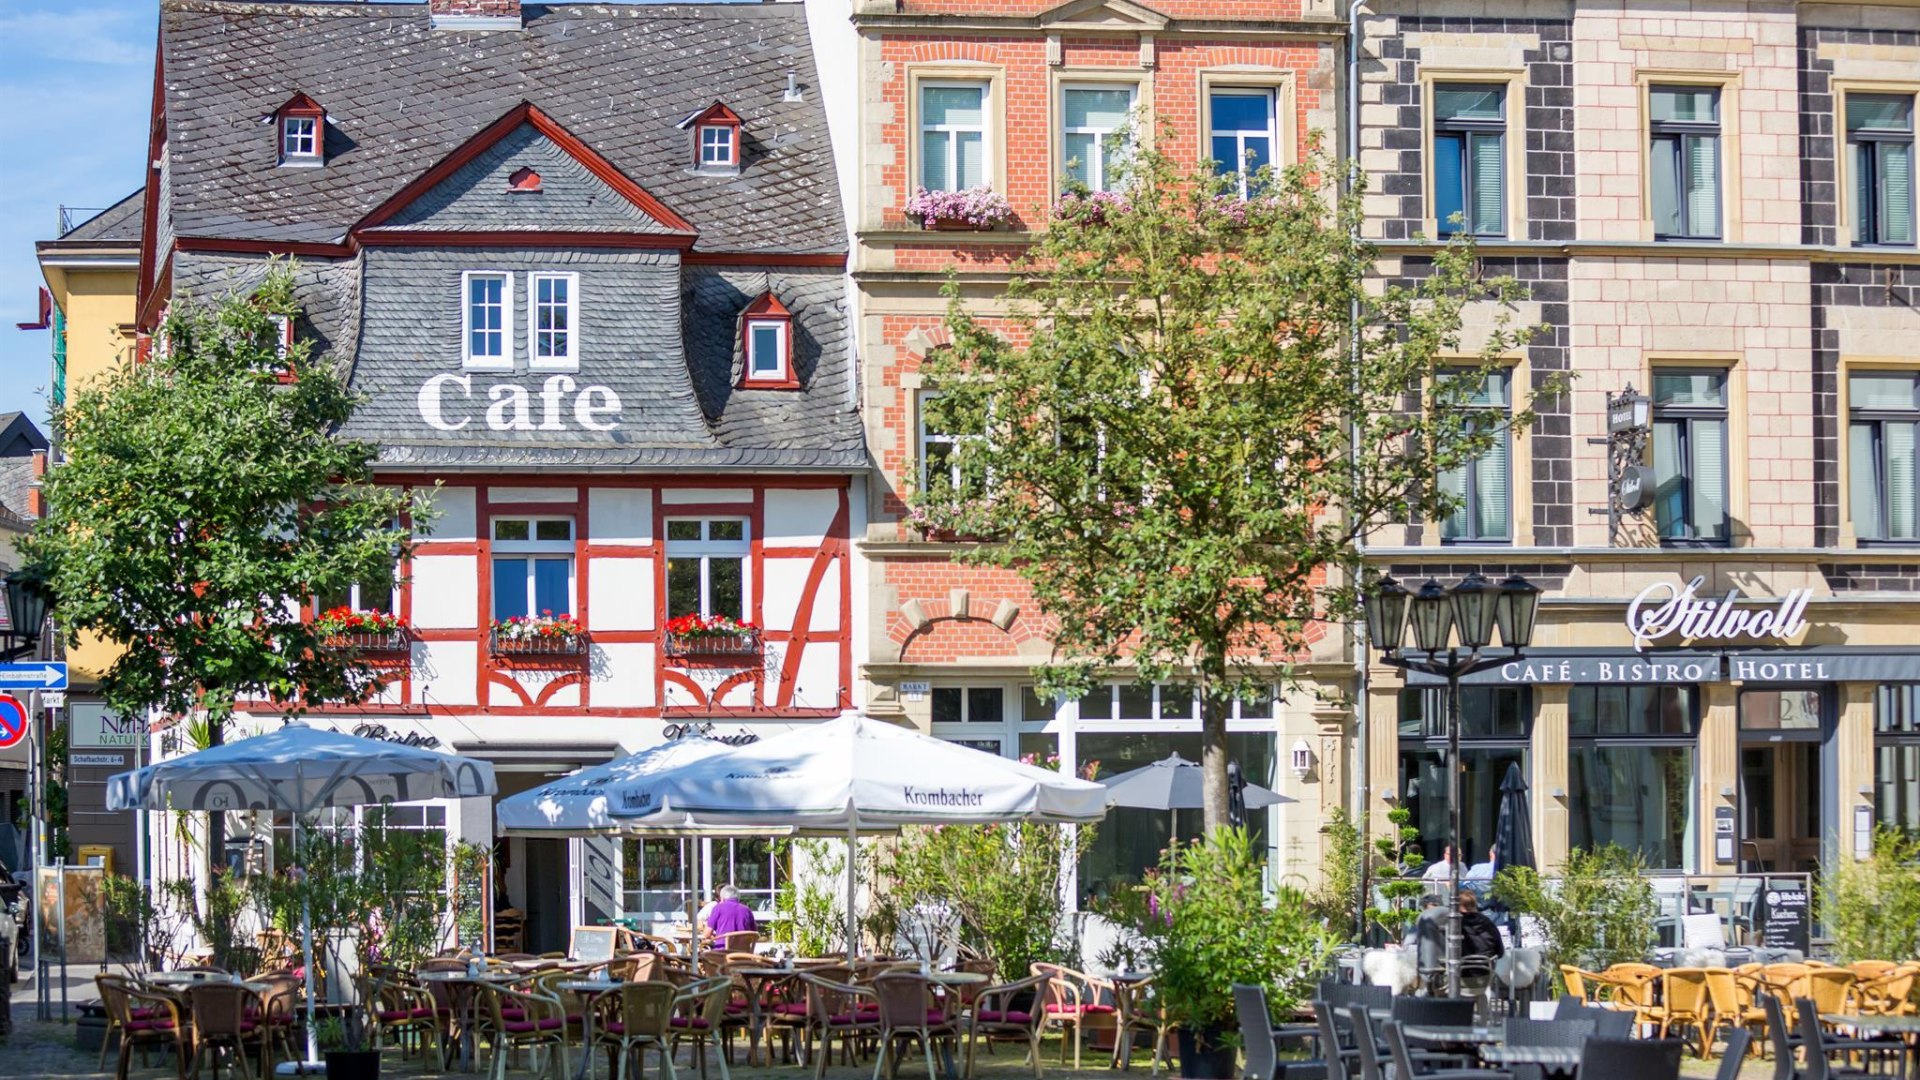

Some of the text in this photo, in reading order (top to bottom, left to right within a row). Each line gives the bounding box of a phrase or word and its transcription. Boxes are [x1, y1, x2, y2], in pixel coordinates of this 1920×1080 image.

[417, 373, 623, 431] Cafe
[1626, 575, 1814, 653] Stilvoll
[1599, 662, 1703, 681] BISTRO
[1736, 661, 1829, 680] HOTEL
[904, 786, 983, 806] Krombacher
